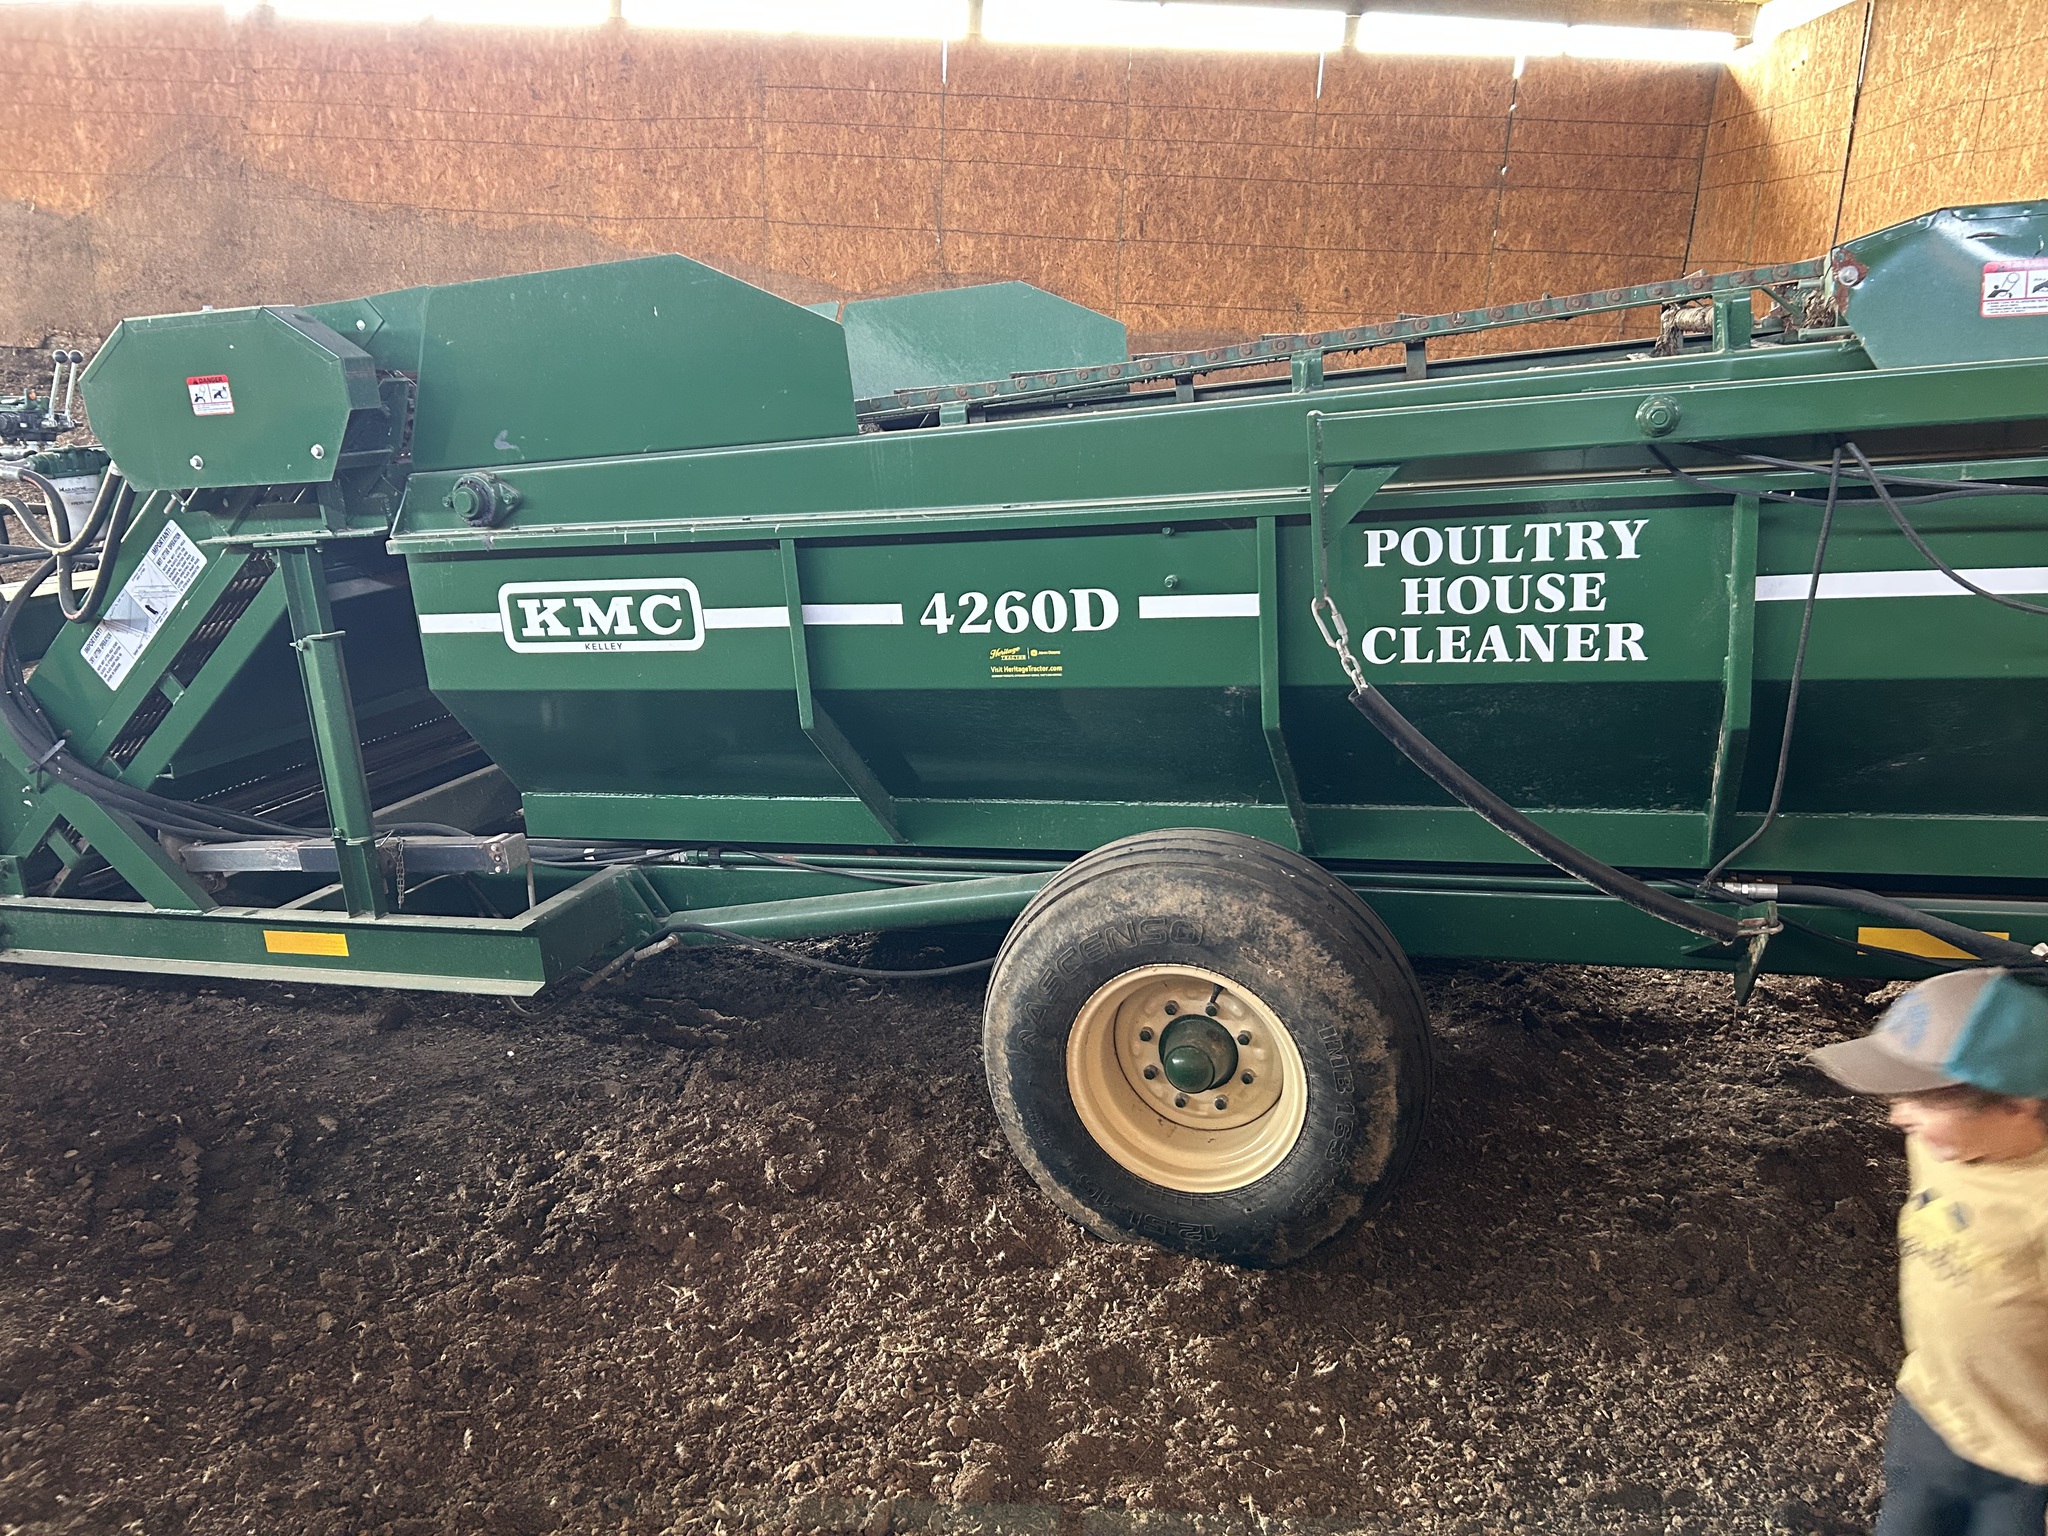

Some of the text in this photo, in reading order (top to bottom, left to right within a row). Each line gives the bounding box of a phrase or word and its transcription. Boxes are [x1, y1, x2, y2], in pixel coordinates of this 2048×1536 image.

[198, 376, 224, 384] DANGER
[150, 527, 172, 556] IMPORTANT!
[1363, 519, 1650, 567] POULTRY
[919, 588, 1120, 634] 4260D
[1400, 573, 1607, 616] HOUSE
[517, 594, 683, 637] KMC
[83, 626, 104, 654] IMPORTANT!
[585, 642, 623, 651] KELLEY
[989, 646, 1021, 660] Heritage
[1362, 623, 1649, 664] CLEANER
[1003, 664, 1063, 674] HeritageTractor.com
[1024, 917, 1204, 1025] ASCENSO
[1317, 1025, 1356, 1164] IMB 163
